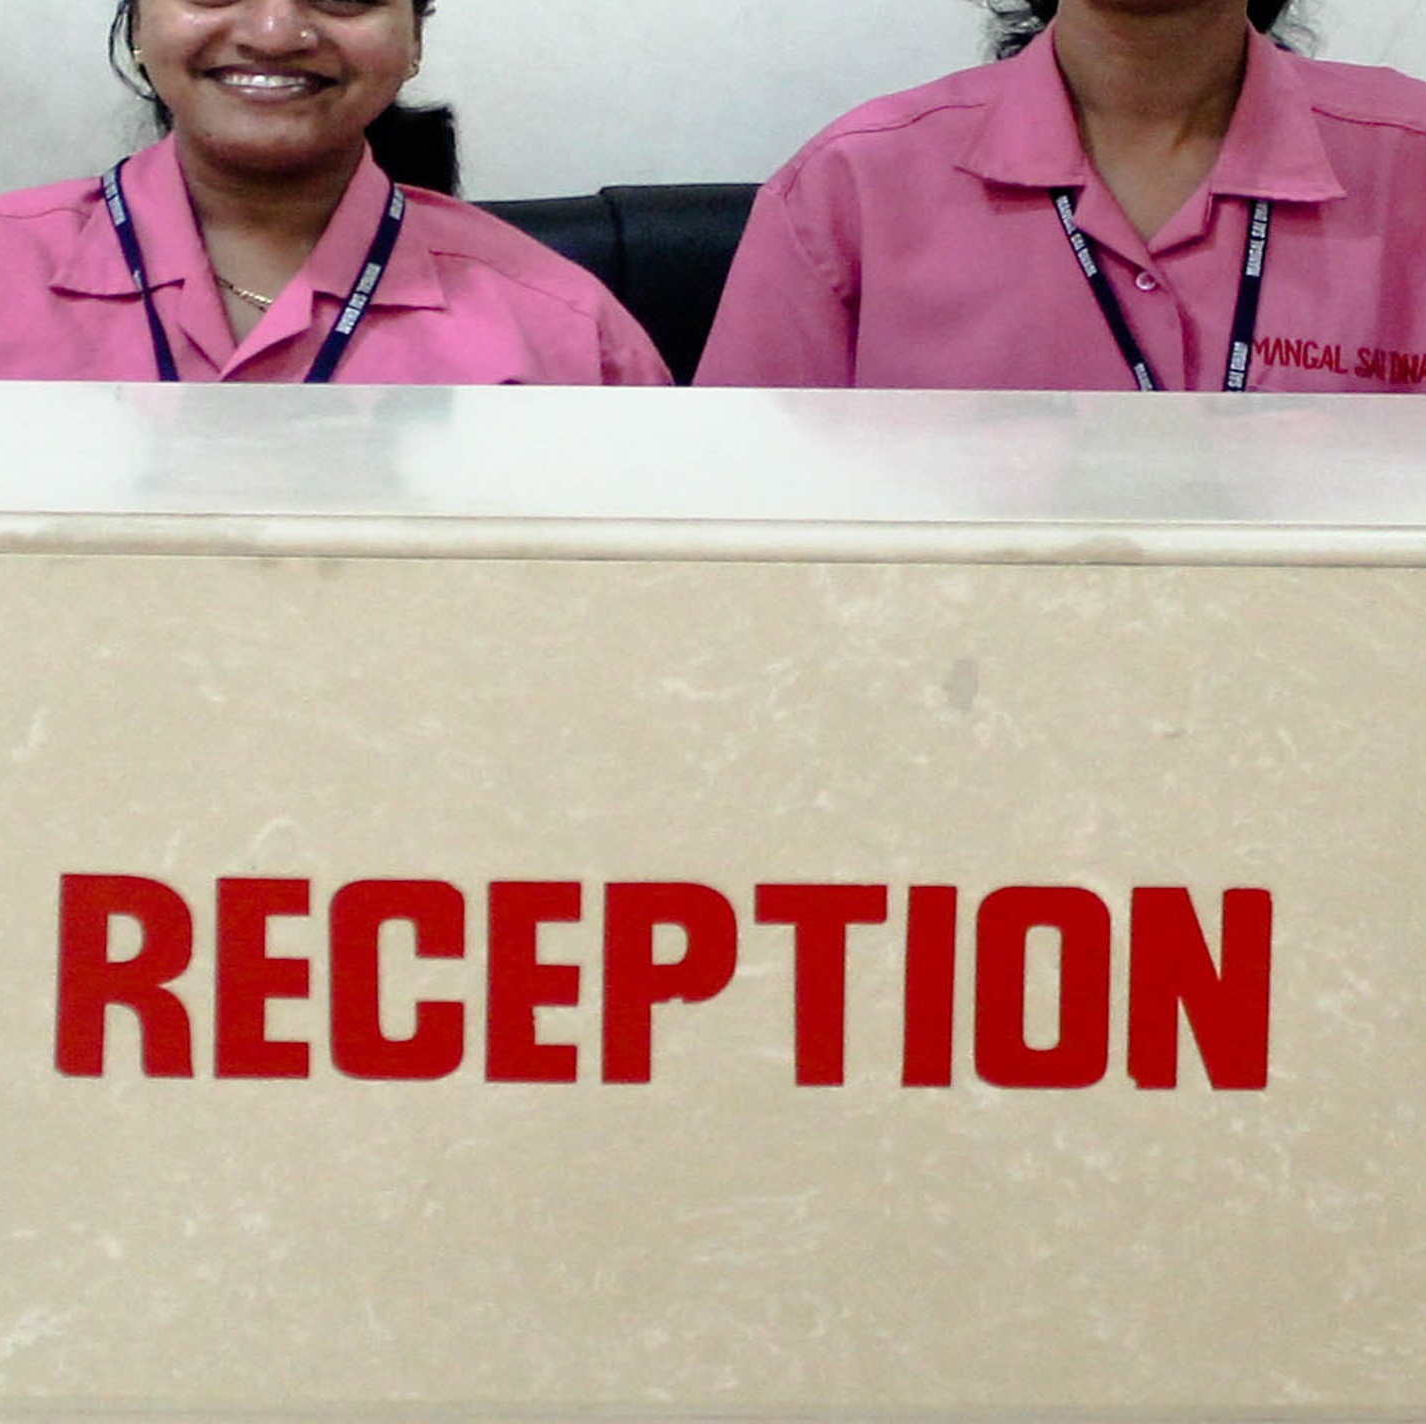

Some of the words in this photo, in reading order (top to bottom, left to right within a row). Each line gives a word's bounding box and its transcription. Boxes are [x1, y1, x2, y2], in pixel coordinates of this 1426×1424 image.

[1254, 337, 1348, 374] MANGAL
[1355, 347, 1386, 382] SAI
[56, 873, 1273, 1090] RECEPTION
